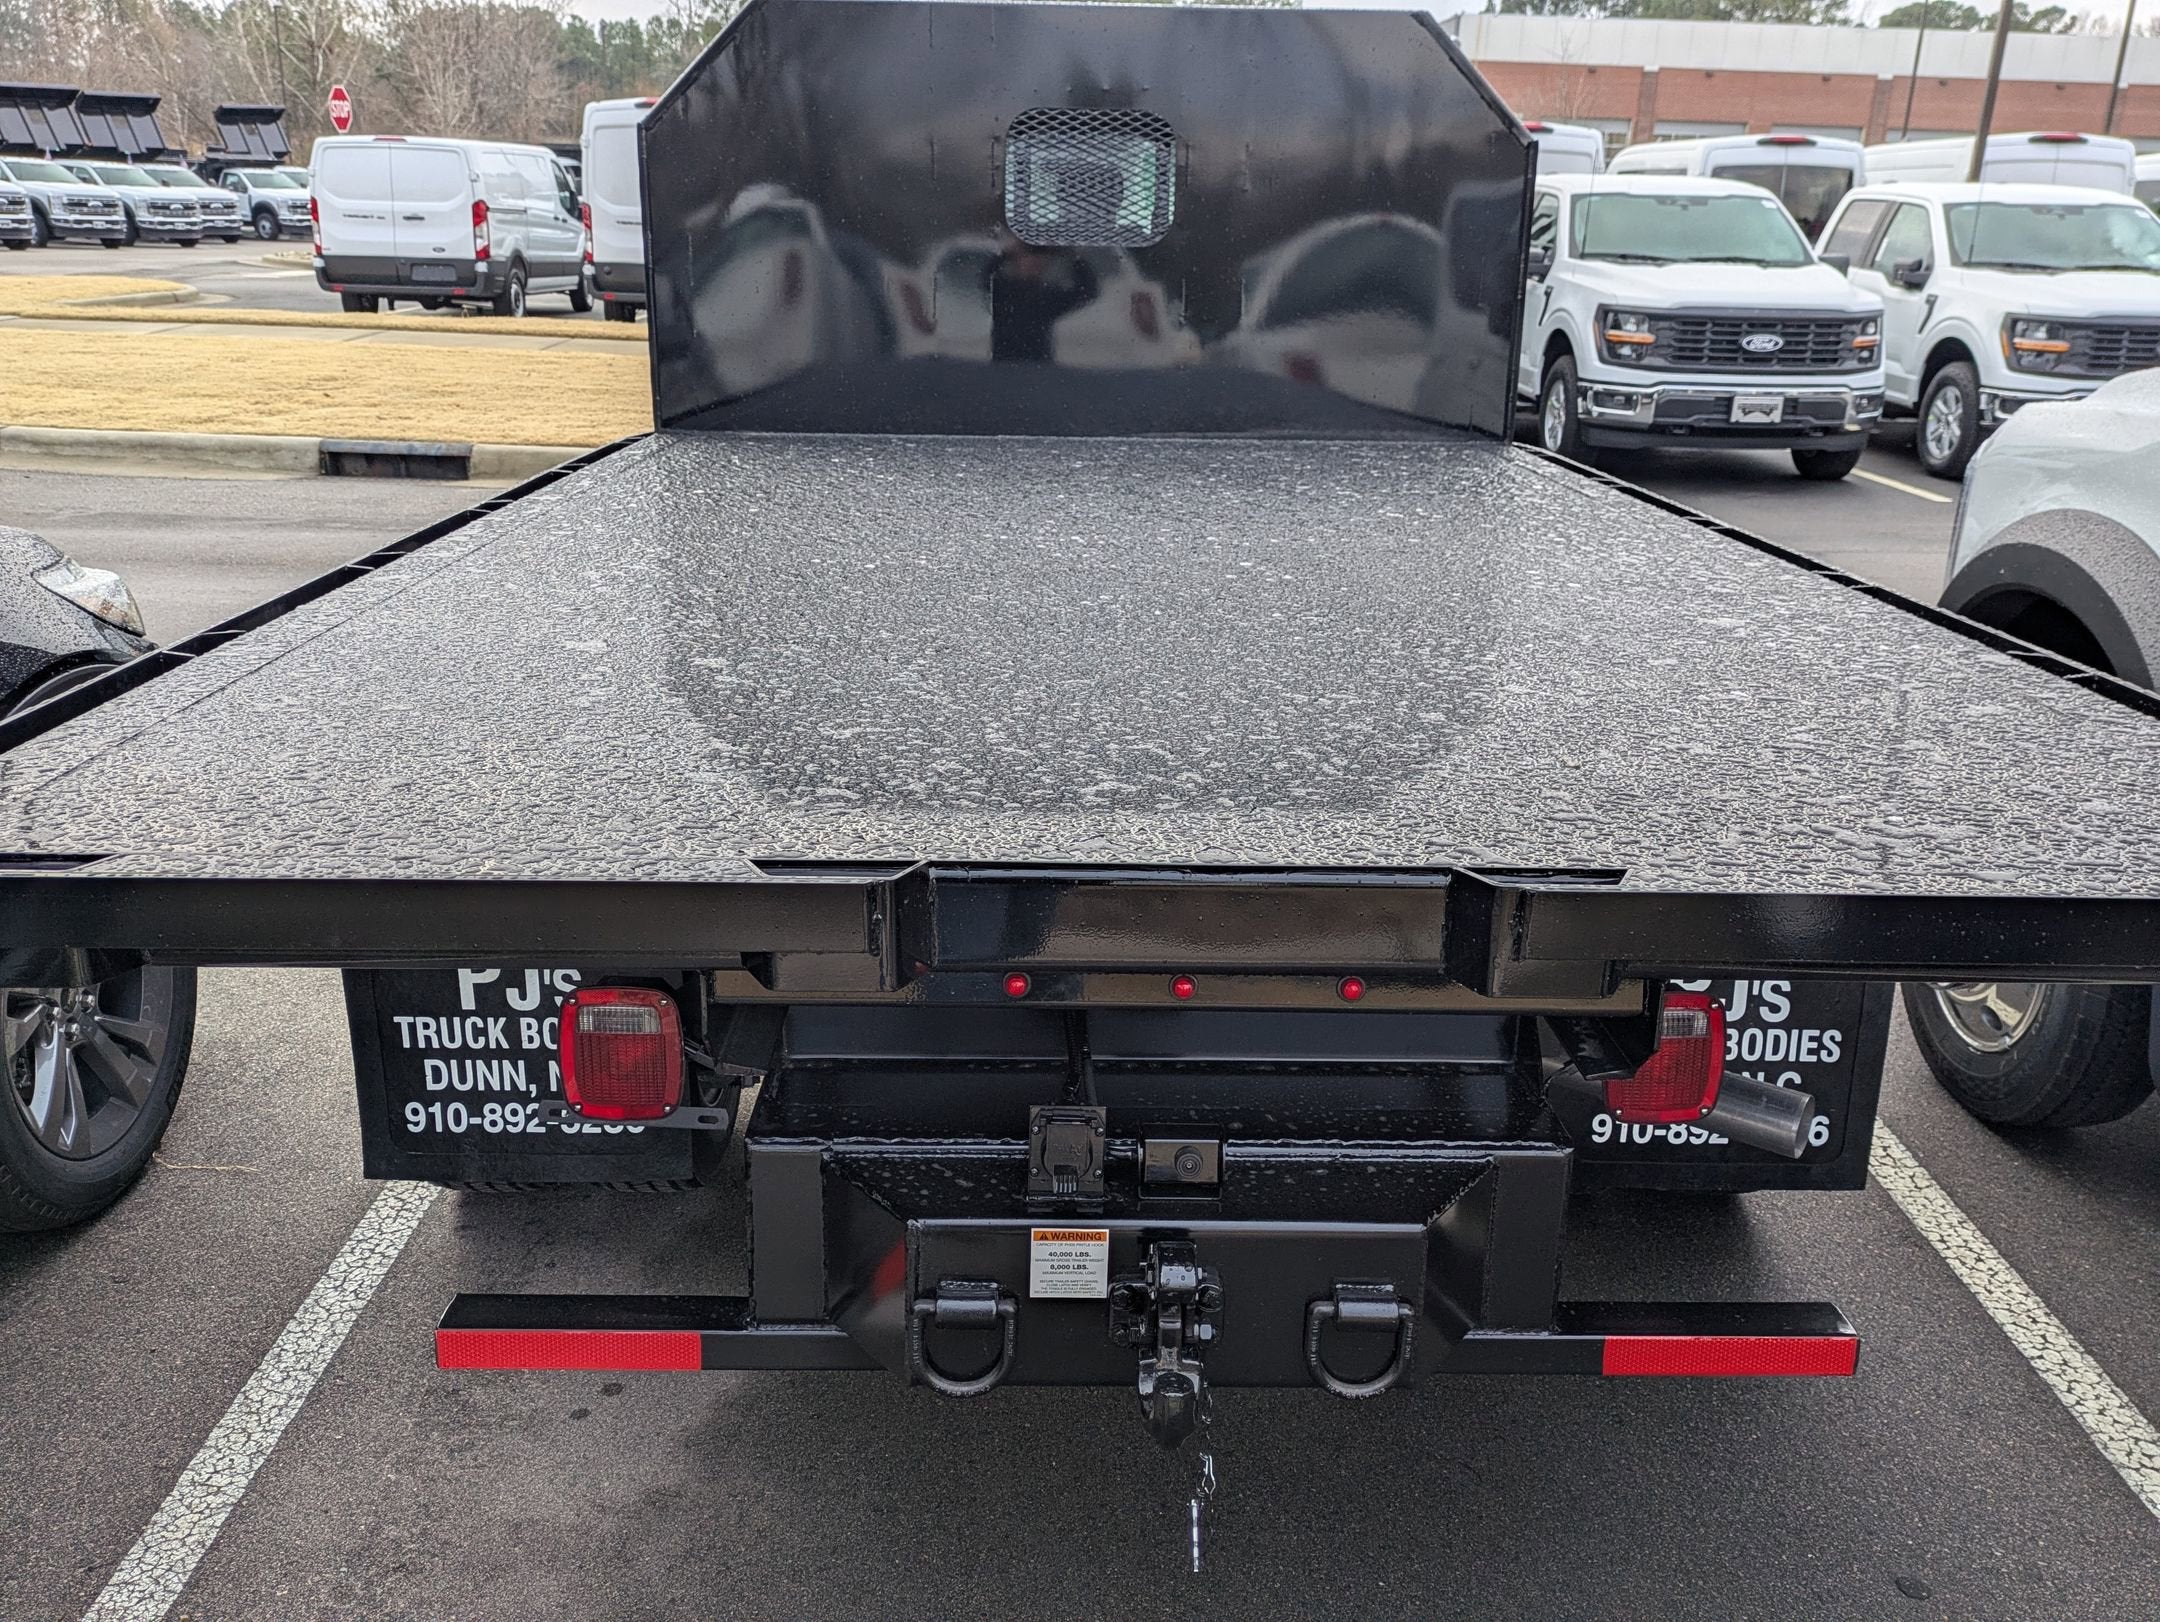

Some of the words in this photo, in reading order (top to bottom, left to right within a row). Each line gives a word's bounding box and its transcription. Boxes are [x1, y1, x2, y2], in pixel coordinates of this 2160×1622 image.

[331, 99, 350, 118] STOP
[393, 1016, 510, 1050] TRUCK
[1725, 1027, 1843, 1064] BODIES
[424, 1059, 538, 1098] DUNN,
[404, 1101, 646, 1134] 910-892
[1050, 1232, 1102, 1241] WARNING
